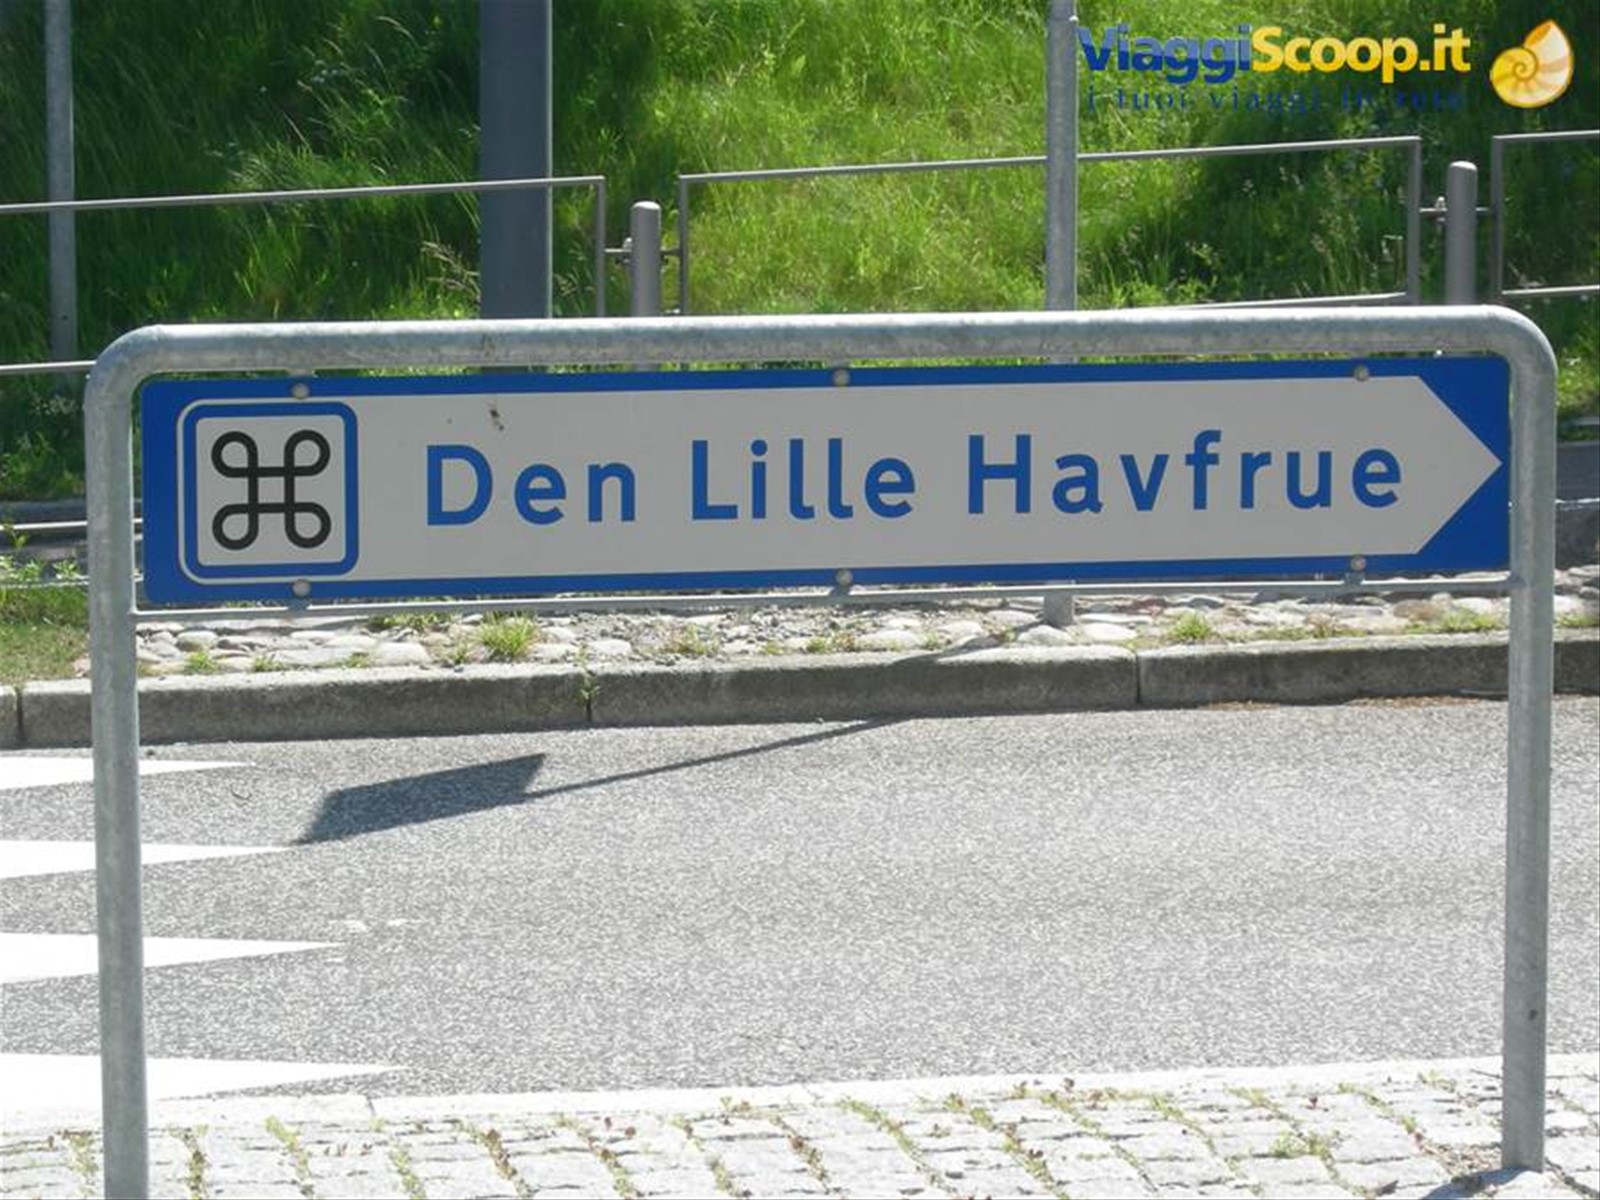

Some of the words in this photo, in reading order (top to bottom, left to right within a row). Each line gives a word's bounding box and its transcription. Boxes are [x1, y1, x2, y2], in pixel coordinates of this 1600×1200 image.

[426, 445, 635, 526] Den
[691, 438, 915, 520] Lille
[967, 430, 1401, 514] Havfrue
